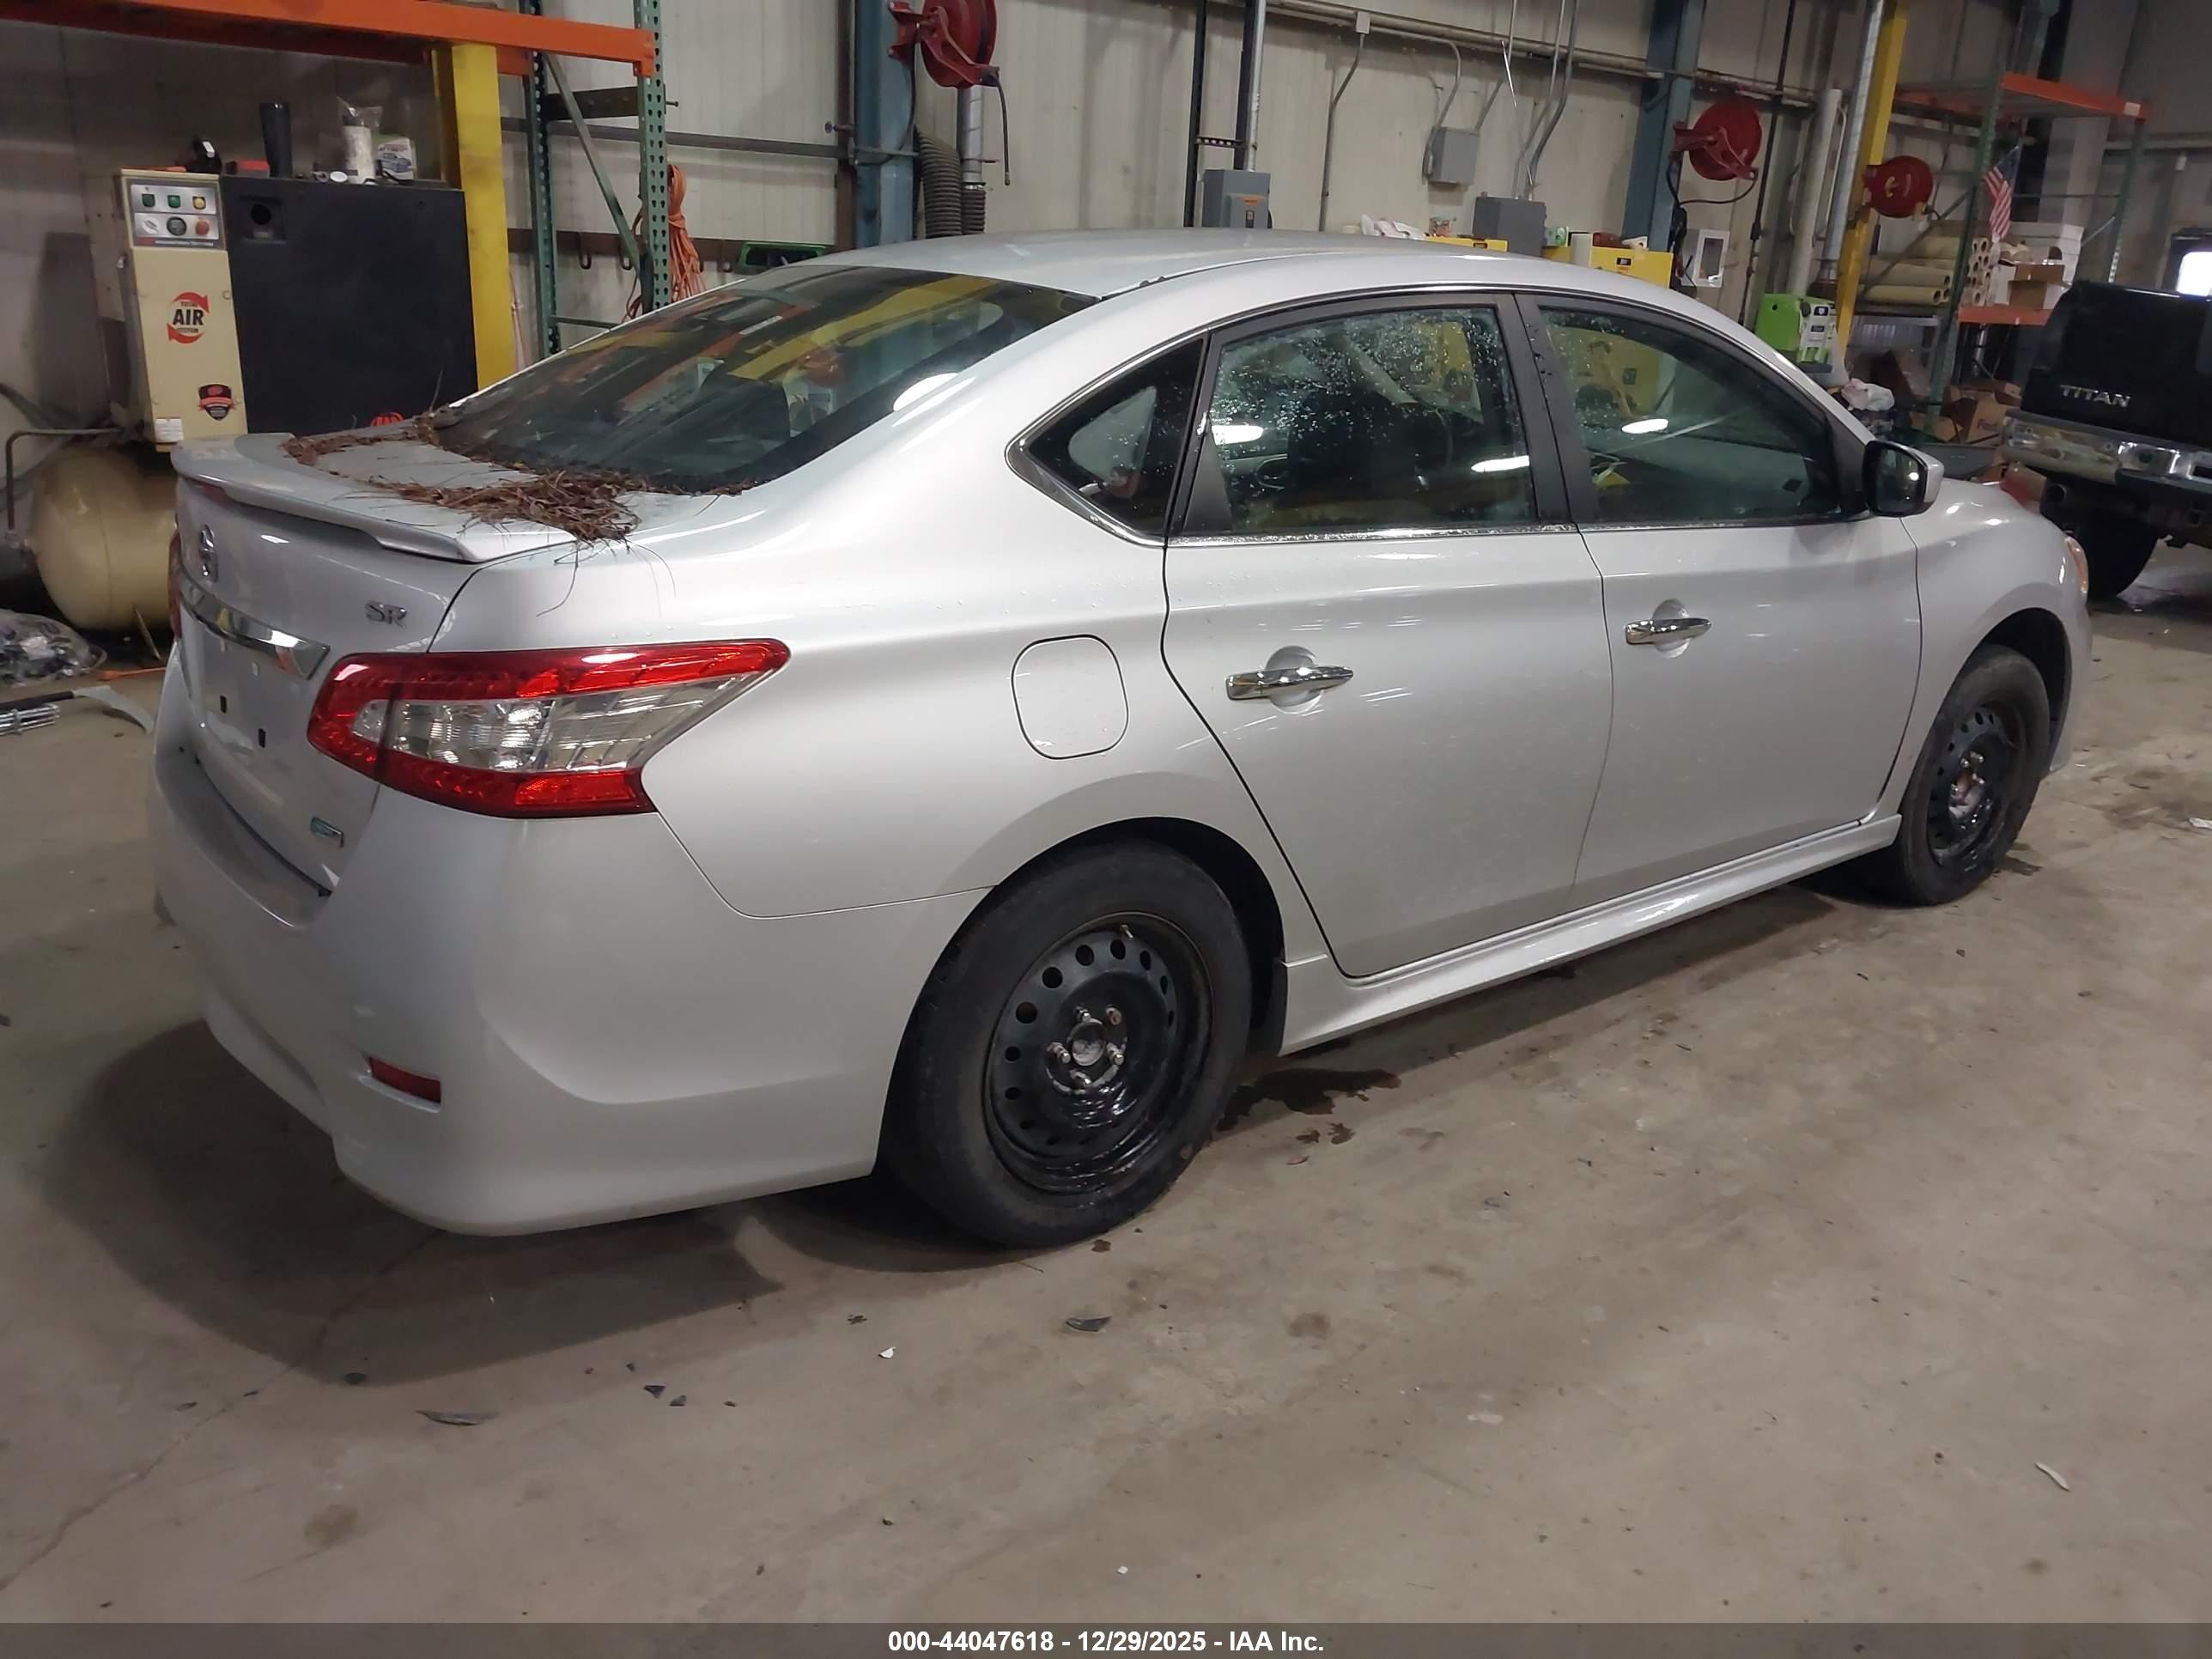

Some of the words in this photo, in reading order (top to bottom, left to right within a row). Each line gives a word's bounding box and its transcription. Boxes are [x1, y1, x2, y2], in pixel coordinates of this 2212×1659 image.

[173, 308, 204, 325] AIR
[2059, 384, 2131, 408] TITAN
[365, 600, 407, 629] SR
